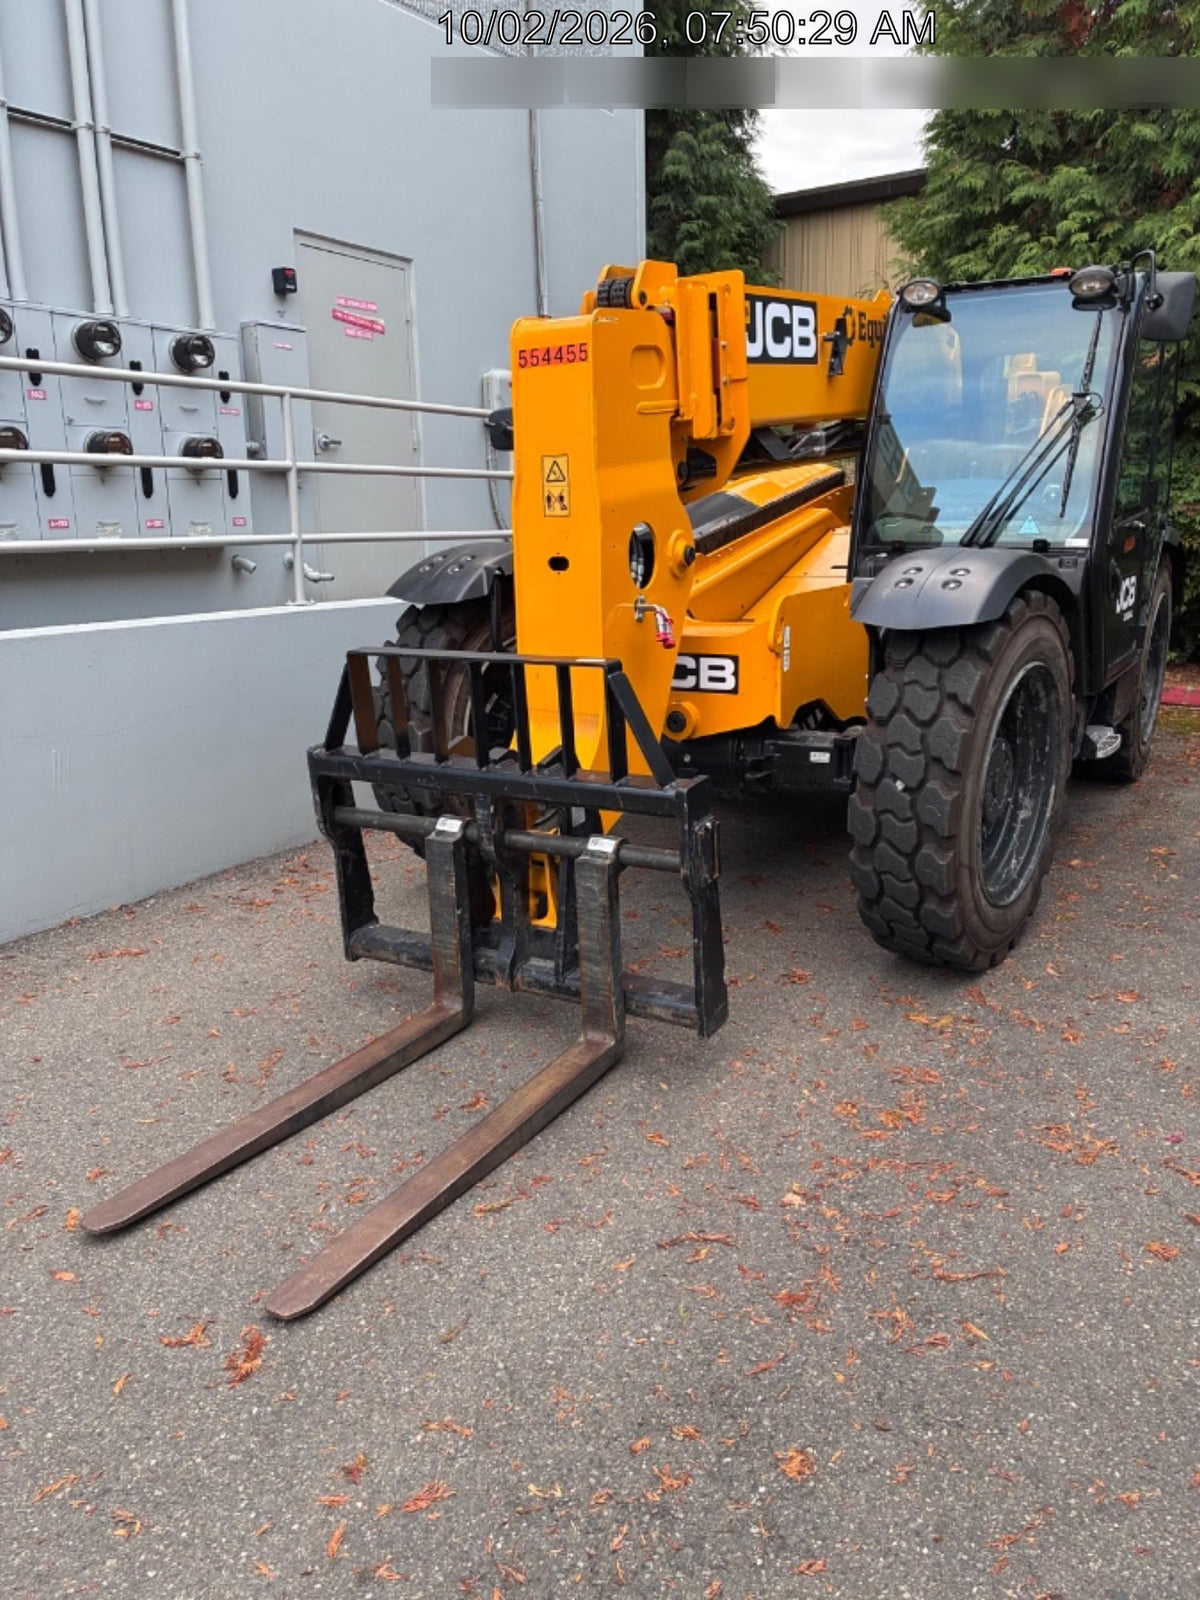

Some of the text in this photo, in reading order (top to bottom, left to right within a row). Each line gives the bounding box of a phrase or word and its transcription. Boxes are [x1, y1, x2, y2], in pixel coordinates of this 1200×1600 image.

[746, 301, 817, 358] JCB
[518, 342, 589, 369] 554455
[1115, 575, 1137, 614] JCB
[671, 655, 737, 691] CB
